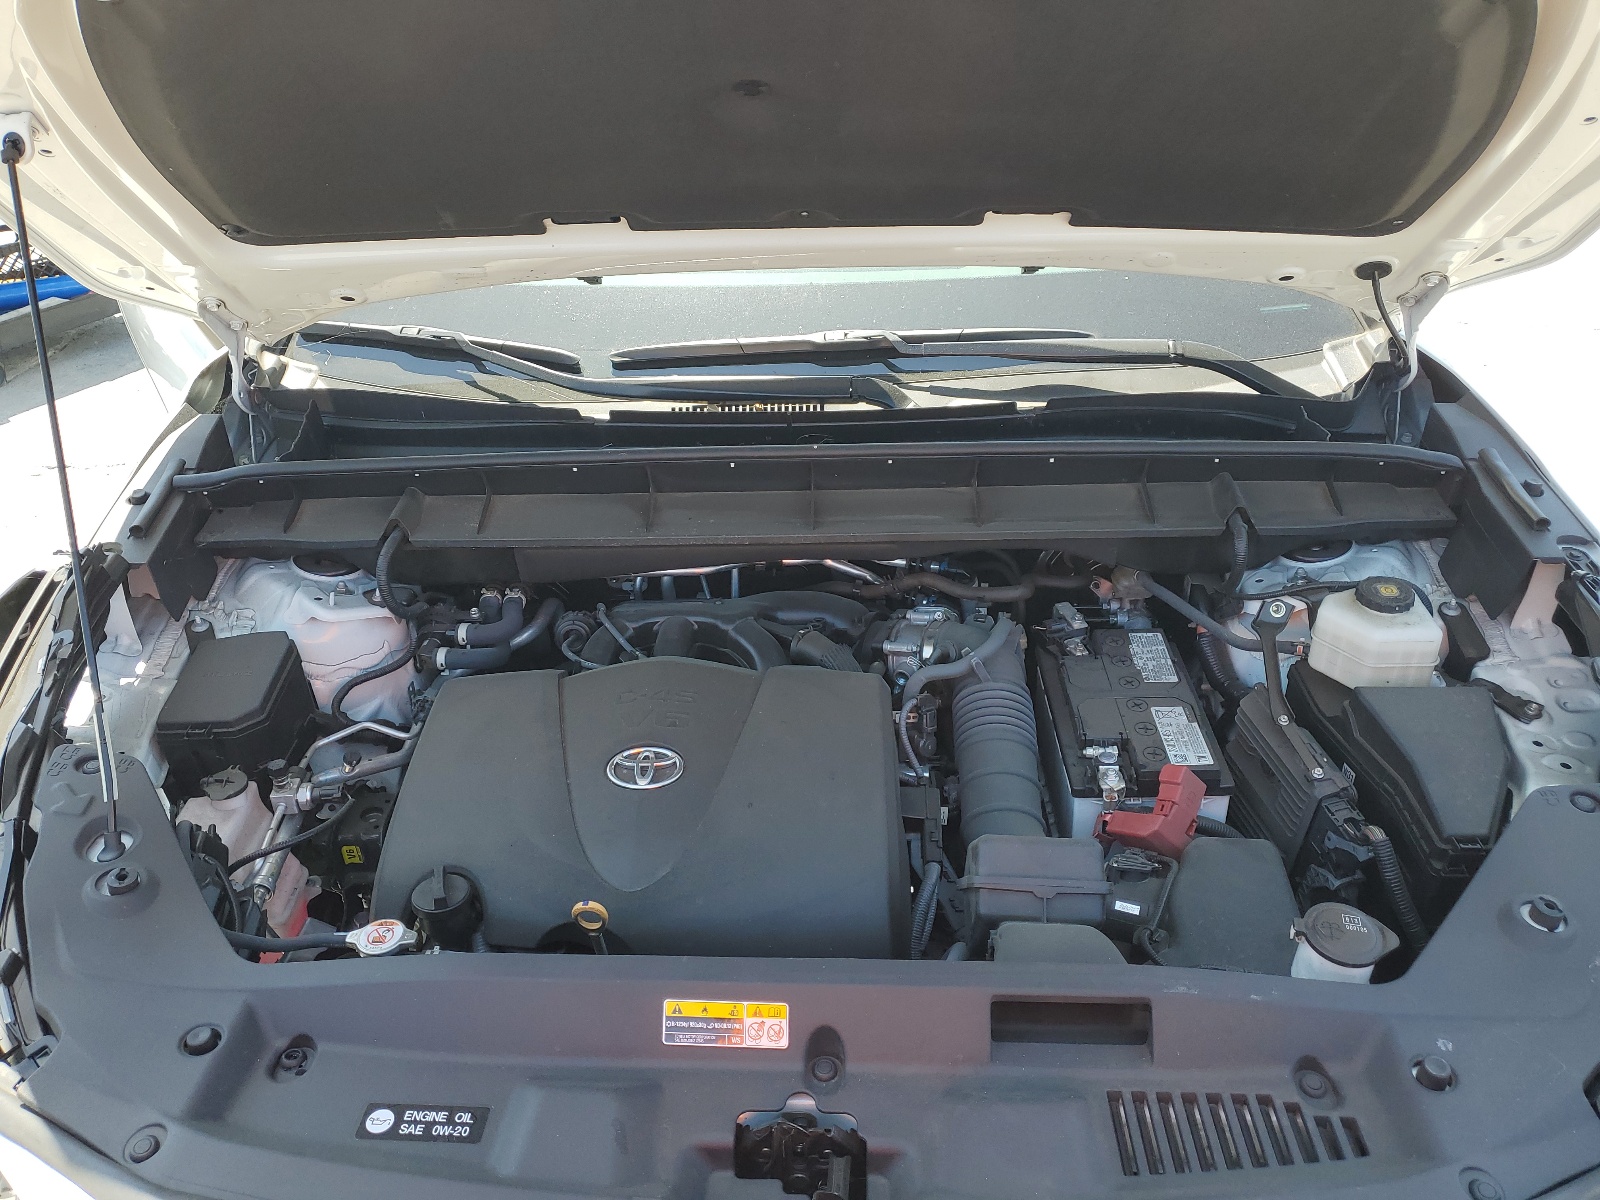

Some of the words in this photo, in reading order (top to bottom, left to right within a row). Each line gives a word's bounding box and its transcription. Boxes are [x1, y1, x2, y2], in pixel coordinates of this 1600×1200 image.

[619, 709, 691, 728] V6
[345, 848, 356, 860] V6
[403, 1110, 449, 1122] ENGINE
[454, 1112, 475, 1123] OIL
[398, 1123, 426, 1135] SAE
